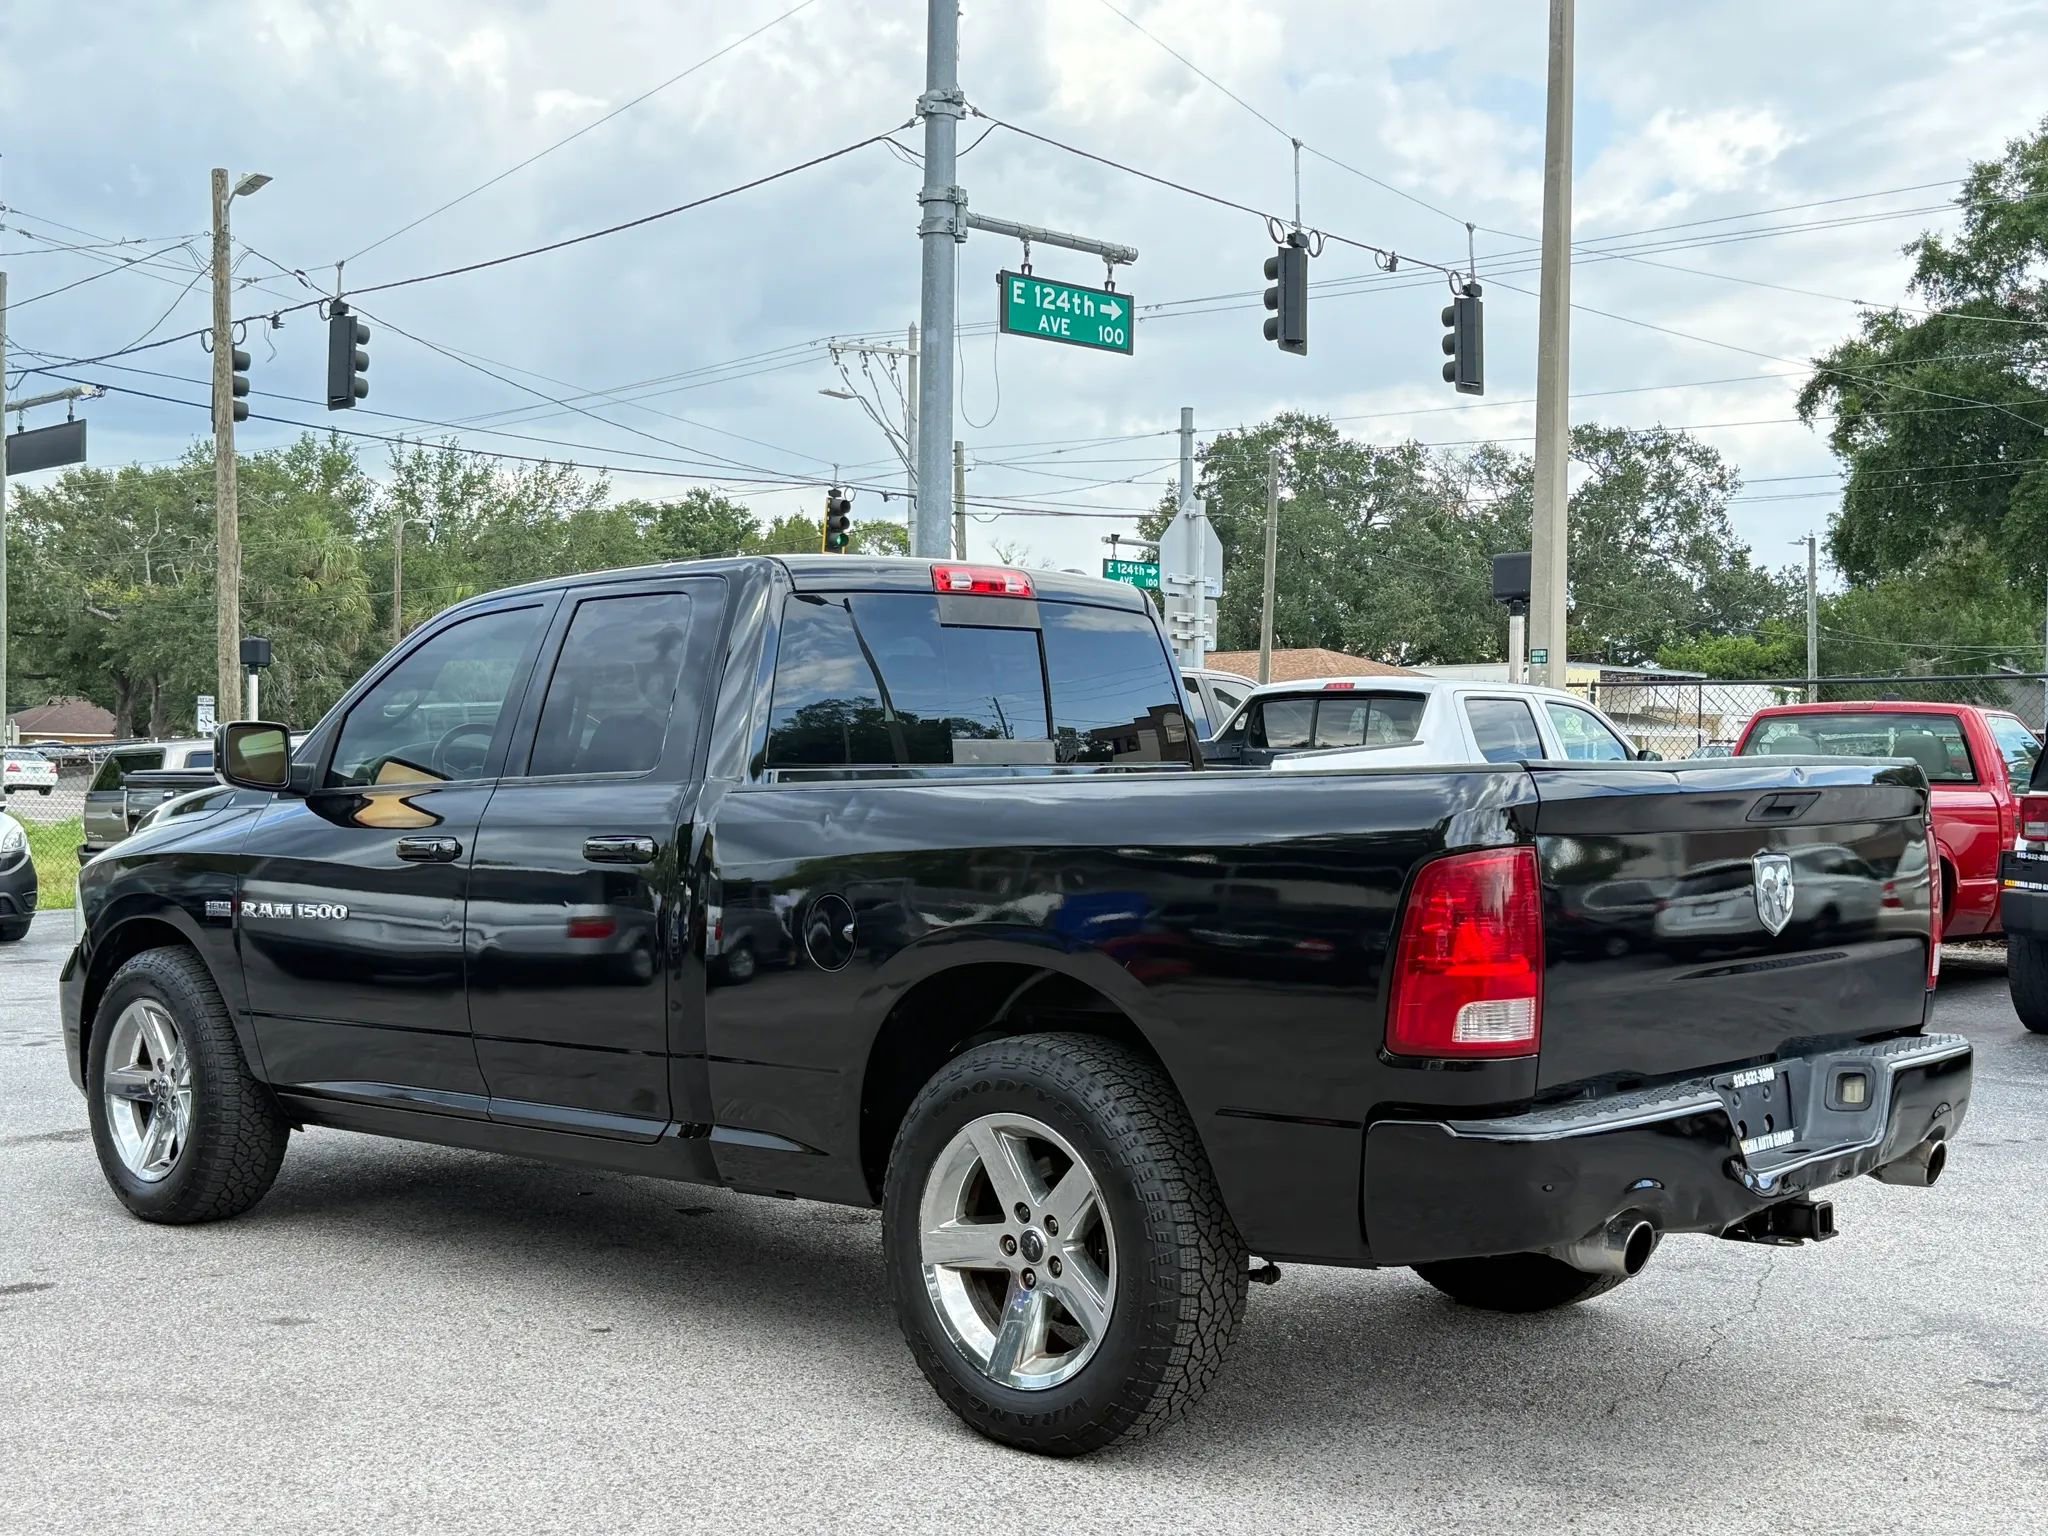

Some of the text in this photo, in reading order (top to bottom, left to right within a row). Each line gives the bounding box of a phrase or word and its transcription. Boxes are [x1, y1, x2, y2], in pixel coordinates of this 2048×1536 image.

[1013, 281, 1095, 317] E 124th
[1038, 314, 1070, 335] AVE
[1098, 325, 1124, 345] 100
[1108, 562, 1144, 576] E 124th
[1120, 576, 1134, 584] AVE
[1146, 578, 1158, 586] 100
[241, 901, 348, 919] RAM 1500
